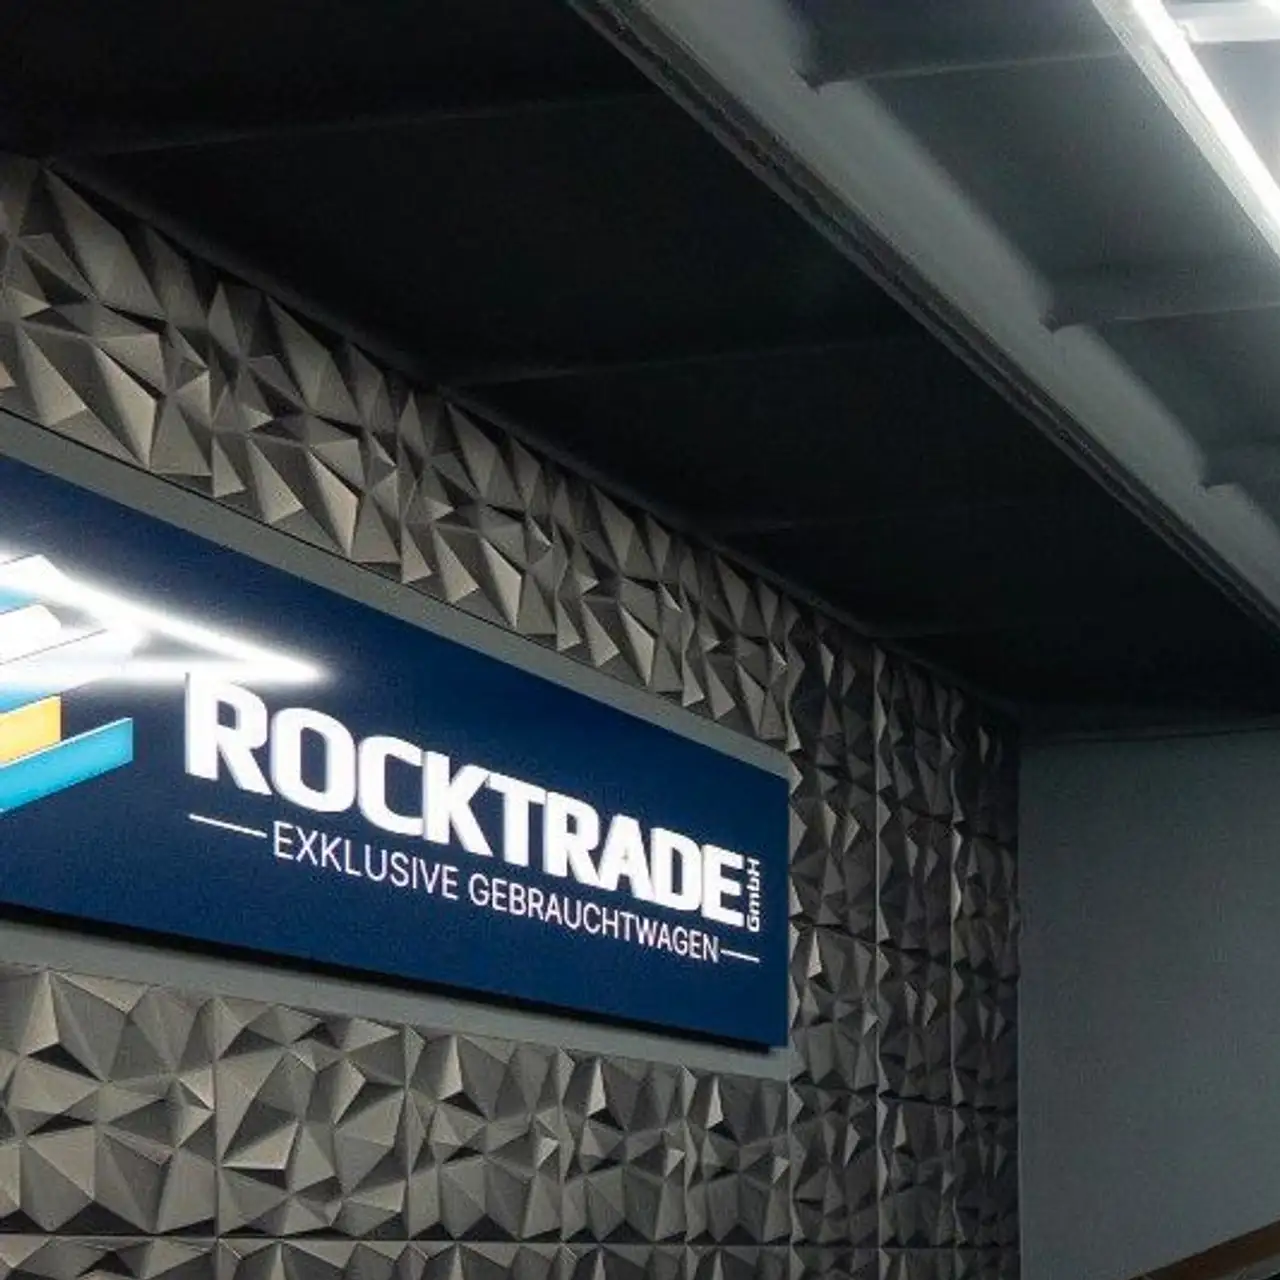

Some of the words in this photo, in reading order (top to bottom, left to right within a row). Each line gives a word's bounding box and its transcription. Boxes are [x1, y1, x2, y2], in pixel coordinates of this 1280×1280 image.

[184, 672, 745, 928] ROCKTRADE
[272, 821, 459, 901] EXKLUSIVE
[468, 872, 720, 963] GEBRAUCHTWAGEN
[746, 857, 760, 932] GmbH
